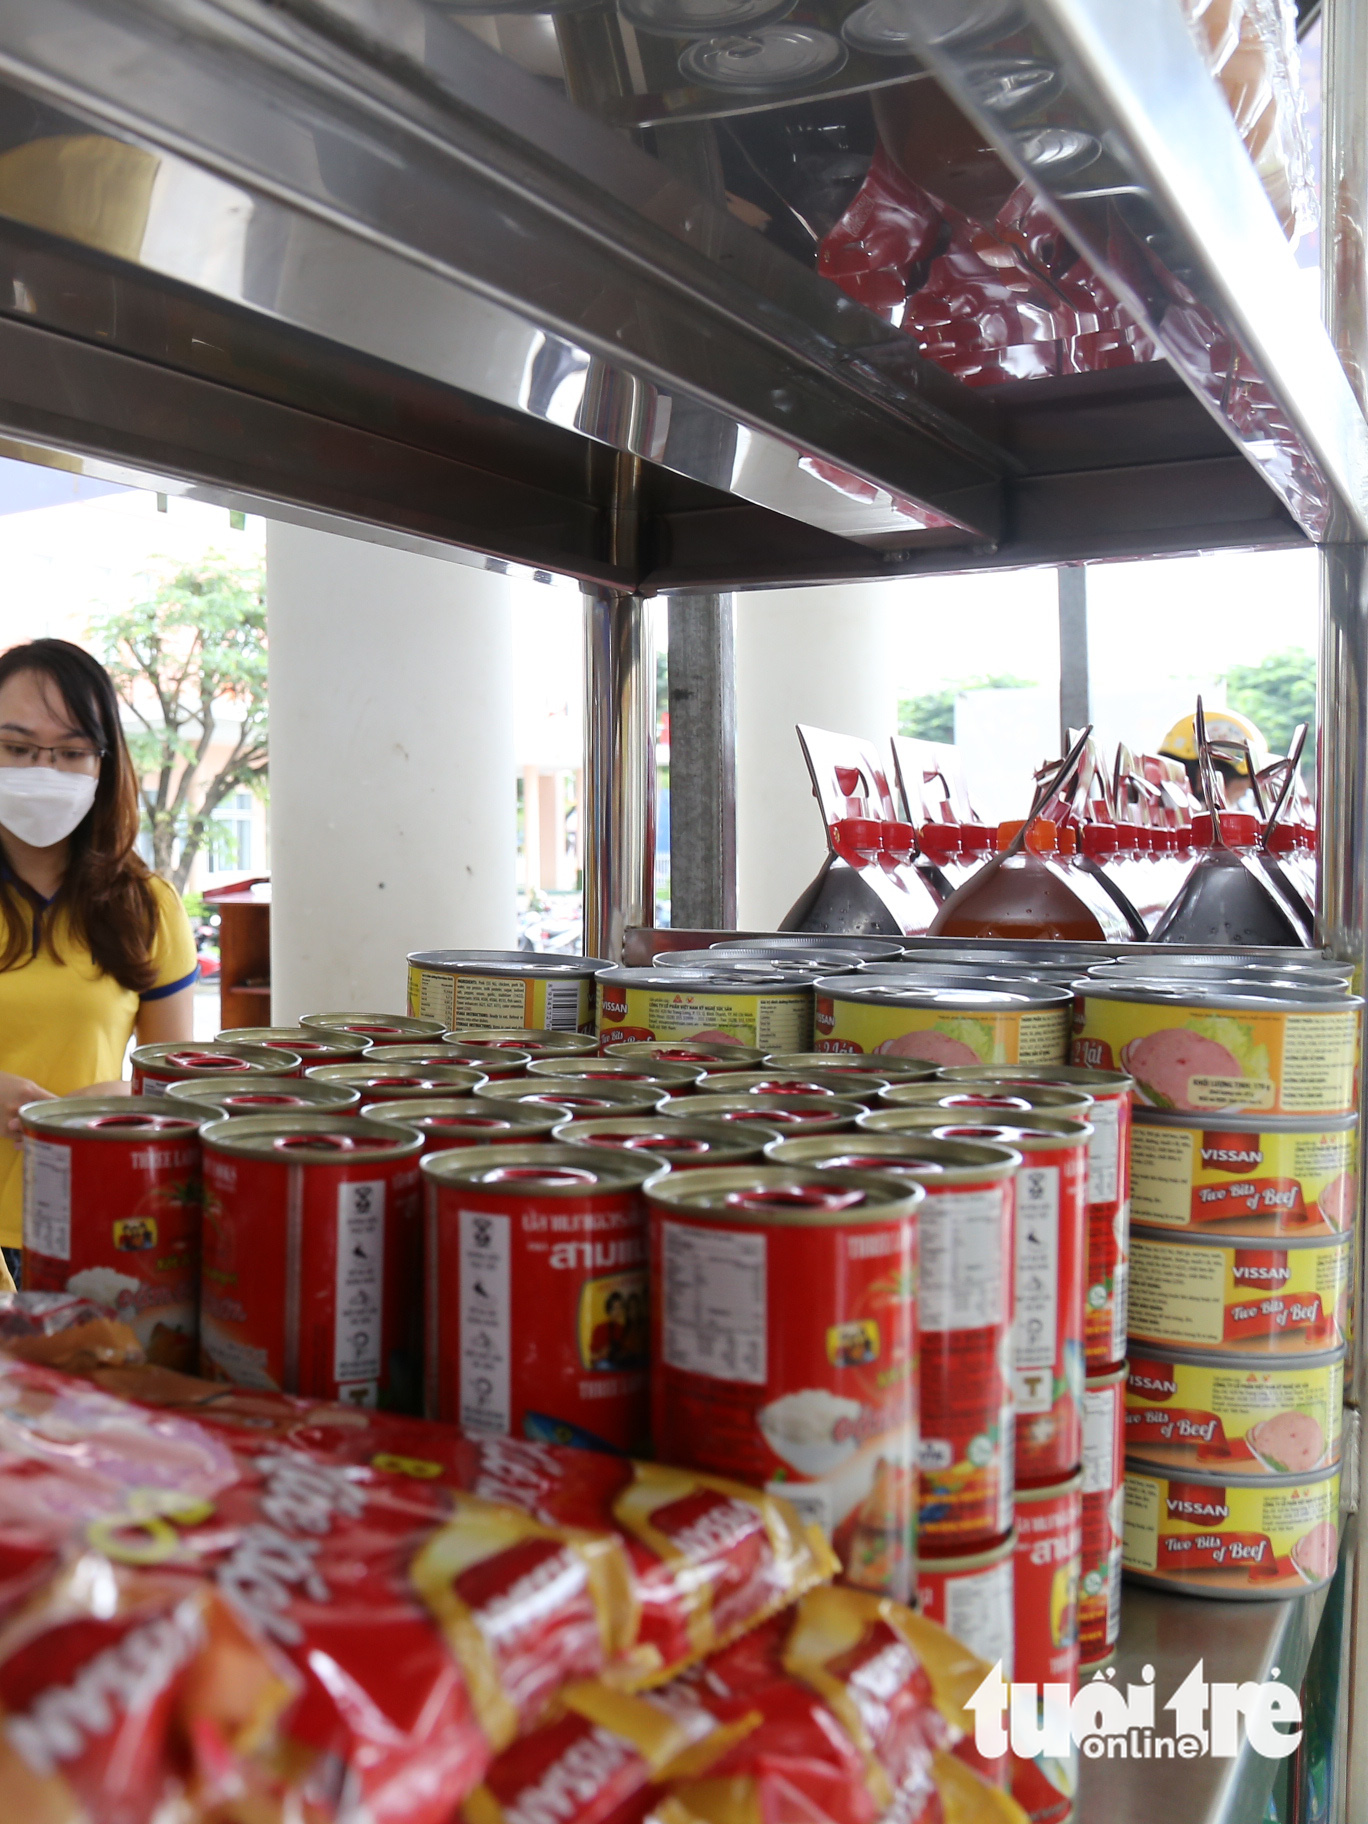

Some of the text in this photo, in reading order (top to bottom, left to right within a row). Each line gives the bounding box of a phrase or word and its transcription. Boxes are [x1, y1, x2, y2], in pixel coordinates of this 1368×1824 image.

[1201, 1148, 1263, 1163] VISSAN
[1199, 1184, 1255, 1203] Two Bits
[1246, 1187, 1299, 1211] of Beef
[1233, 1266, 1291, 1279] VISSAN
[1232, 1300, 1284, 1321] Two Bits
[1276, 1301, 1319, 1326] of Beef
[1129, 1374, 1177, 1393] ISSAN
[1143, 1411, 1169, 1424] Bits
[1160, 1420, 1217, 1441] of Beef
[1166, 1498, 1229, 1517] VISSAN
[1165, 1536, 1221, 1551] Two Bits
[1213, 1540, 1267, 1563] of Beef
